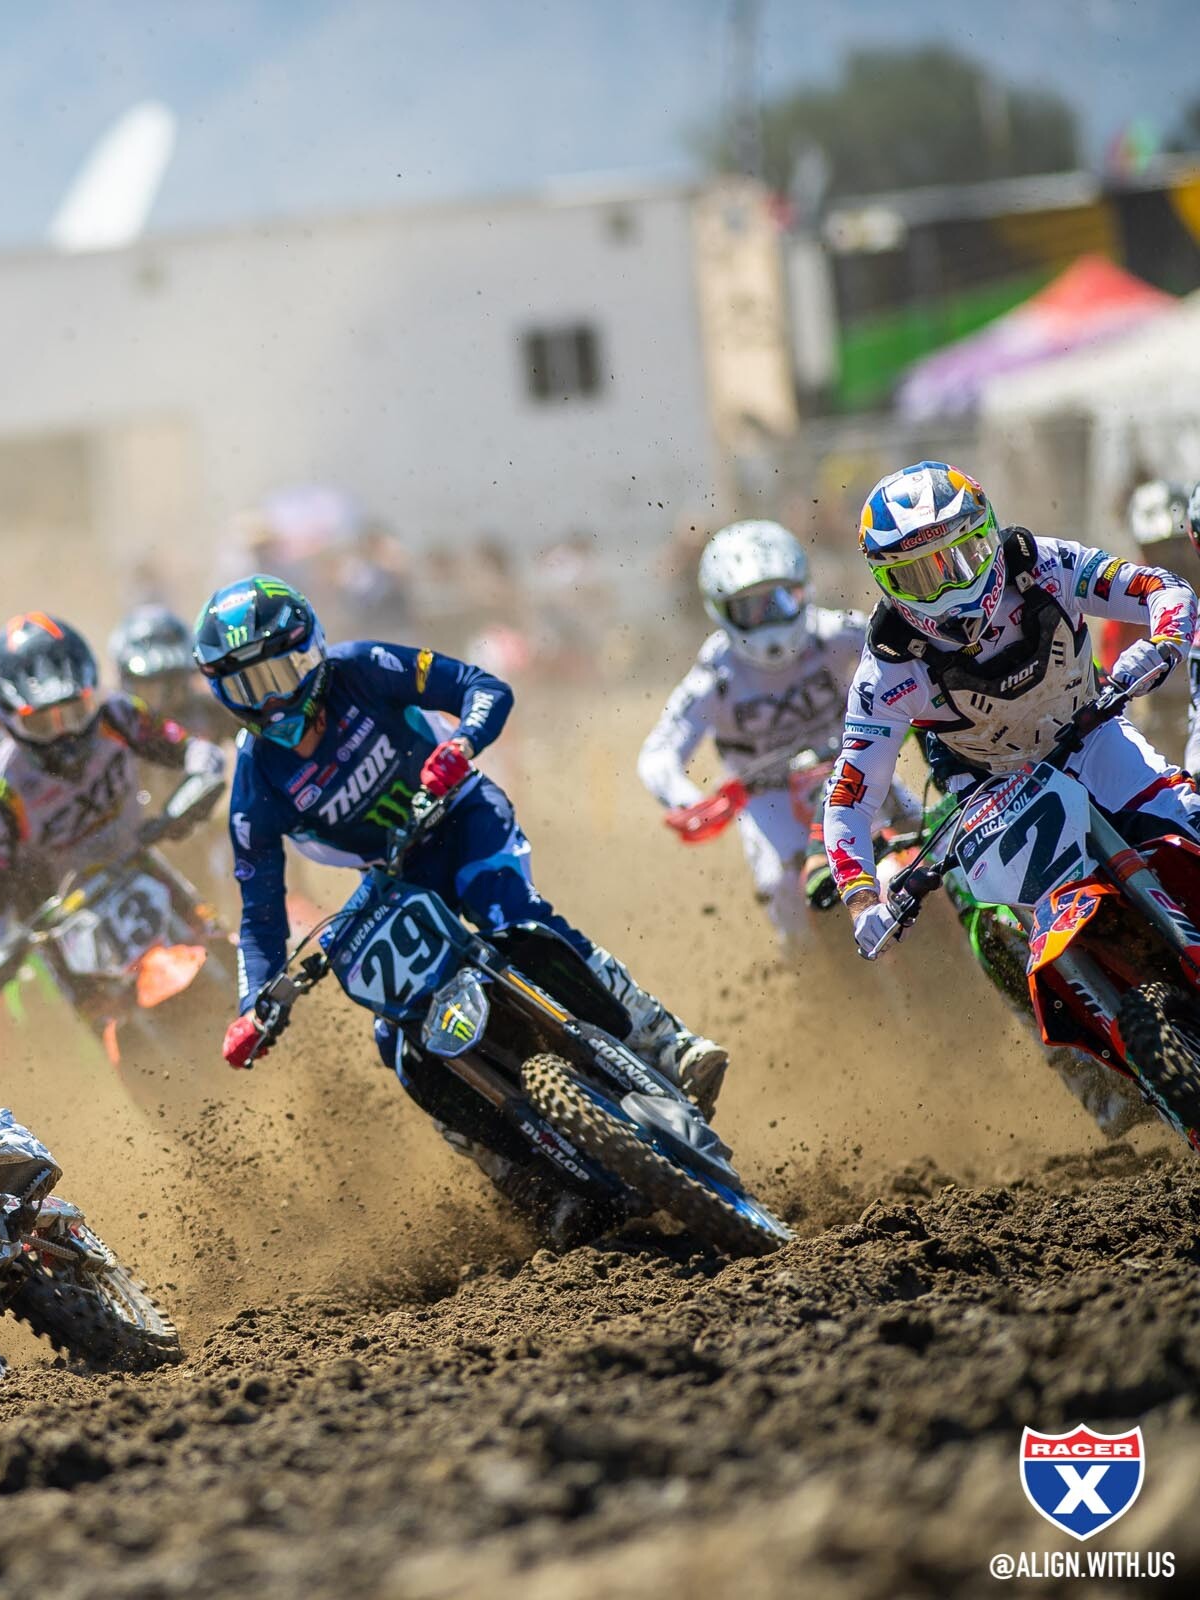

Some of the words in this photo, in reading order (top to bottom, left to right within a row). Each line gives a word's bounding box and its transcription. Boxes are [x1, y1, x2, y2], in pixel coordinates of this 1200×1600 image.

[901, 532, 924, 550] Red
[925, 524, 948, 540] Bull
[1000, 660, 1039, 692] thor
[318, 733, 397, 826] THOR
[1013, 792, 1031, 813] OIL
[999, 791, 1082, 904] 2
[360, 900, 445, 1006] 29
